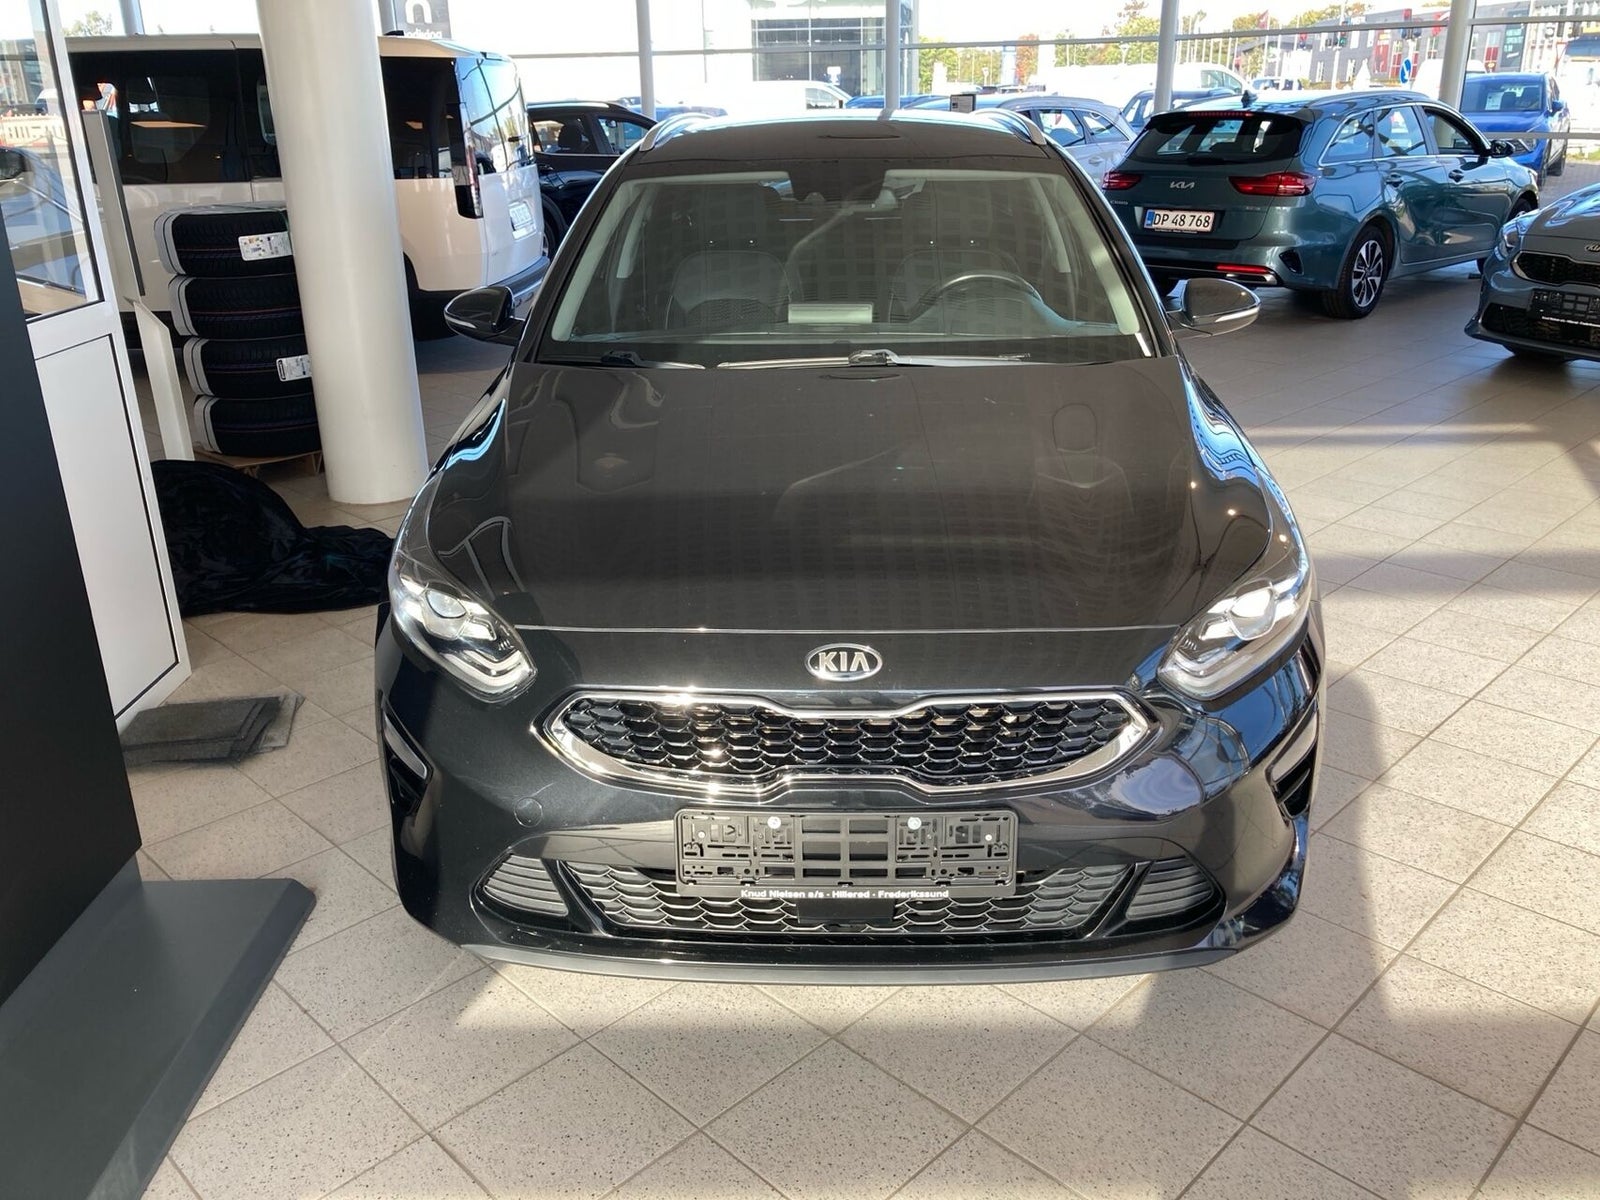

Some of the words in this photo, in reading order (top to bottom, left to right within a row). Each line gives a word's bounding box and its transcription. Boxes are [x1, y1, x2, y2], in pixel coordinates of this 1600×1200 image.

[1153, 213, 1170, 226] DP
[1172, 214, 1186, 227] 48
[1188, 214, 1211, 228] 768
[818, 651, 871, 672] KIA
[740, 889, 767, 898] Knud
[768, 889, 806, 899] Nielsen
[877, 890, 949, 899] Frederikssund
